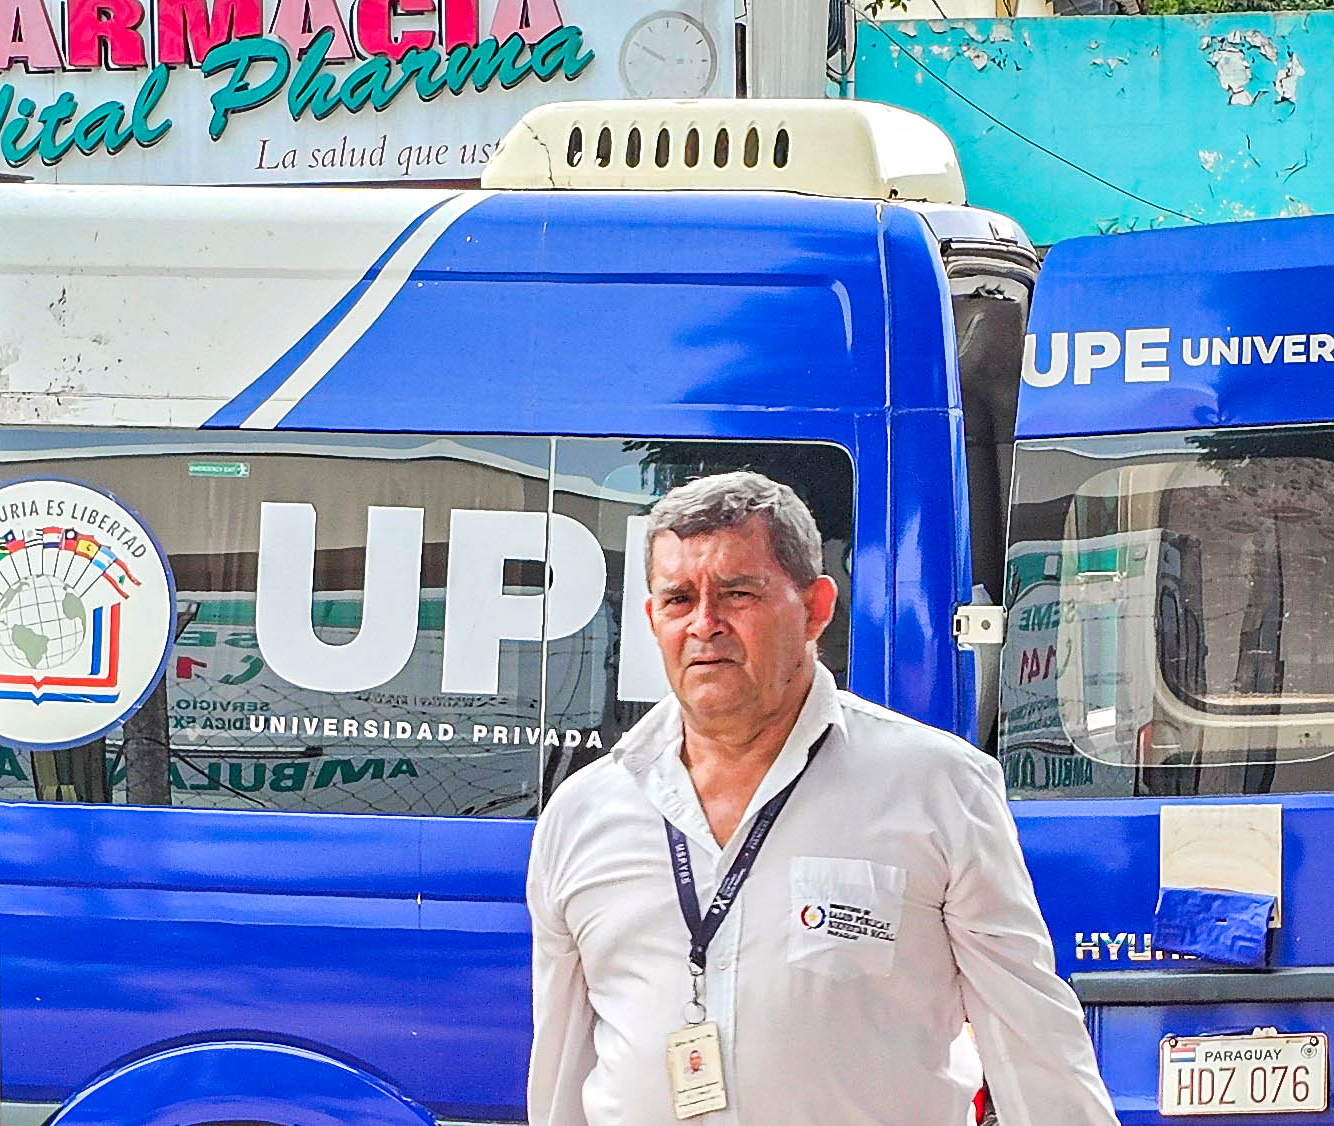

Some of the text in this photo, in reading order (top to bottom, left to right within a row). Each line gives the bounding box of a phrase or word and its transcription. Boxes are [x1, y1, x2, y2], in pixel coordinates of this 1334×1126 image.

[201, 25, 596, 141] Pharma
[255, 138, 298, 170] La
[307, 135, 388, 168] salud
[397, 146, 449, 176] que
[1021, 327, 1171, 387] UPE
[46, 500, 65, 516] ES
[71, 503, 146, 558] LIBERTAD
[250, 714, 604, 749] UNIVERSIDAD PRIVADA
[1204, 1048, 1282, 1063] PARAGUAY
[1176, 1064, 1310, 1106] HDZ 076
